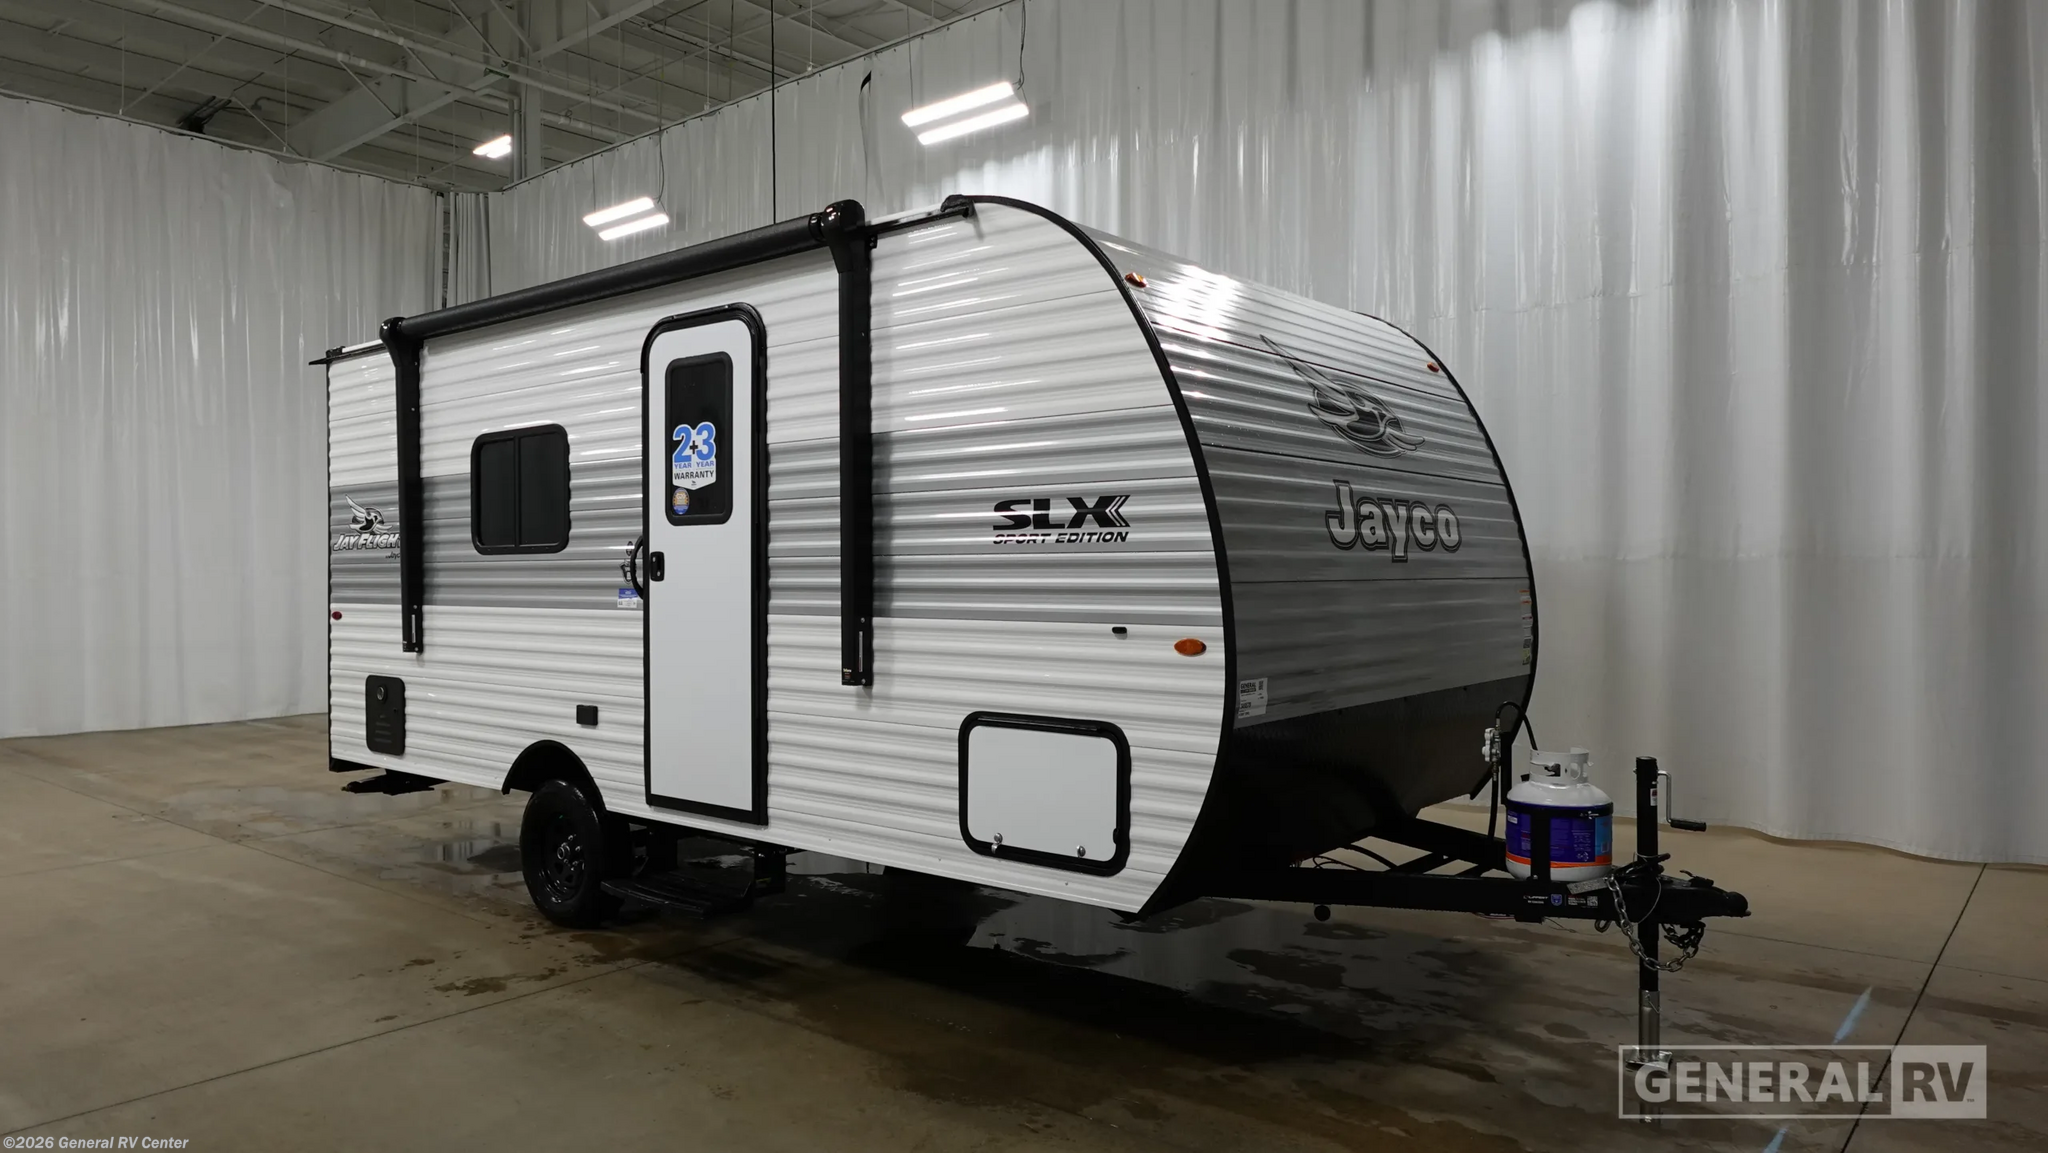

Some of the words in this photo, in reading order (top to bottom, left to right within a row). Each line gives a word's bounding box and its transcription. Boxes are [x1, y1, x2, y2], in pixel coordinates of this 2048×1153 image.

[674, 471, 714, 480] WARRANTY
[993, 495, 1131, 530] SLX
[1325, 479, 1462, 563] Jayco
[333, 533, 359, 551] JAY
[357, 533, 401, 550] FLIGH
[993, 533, 1052, 544] SPORT
[1055, 531, 1129, 543] EDITION
